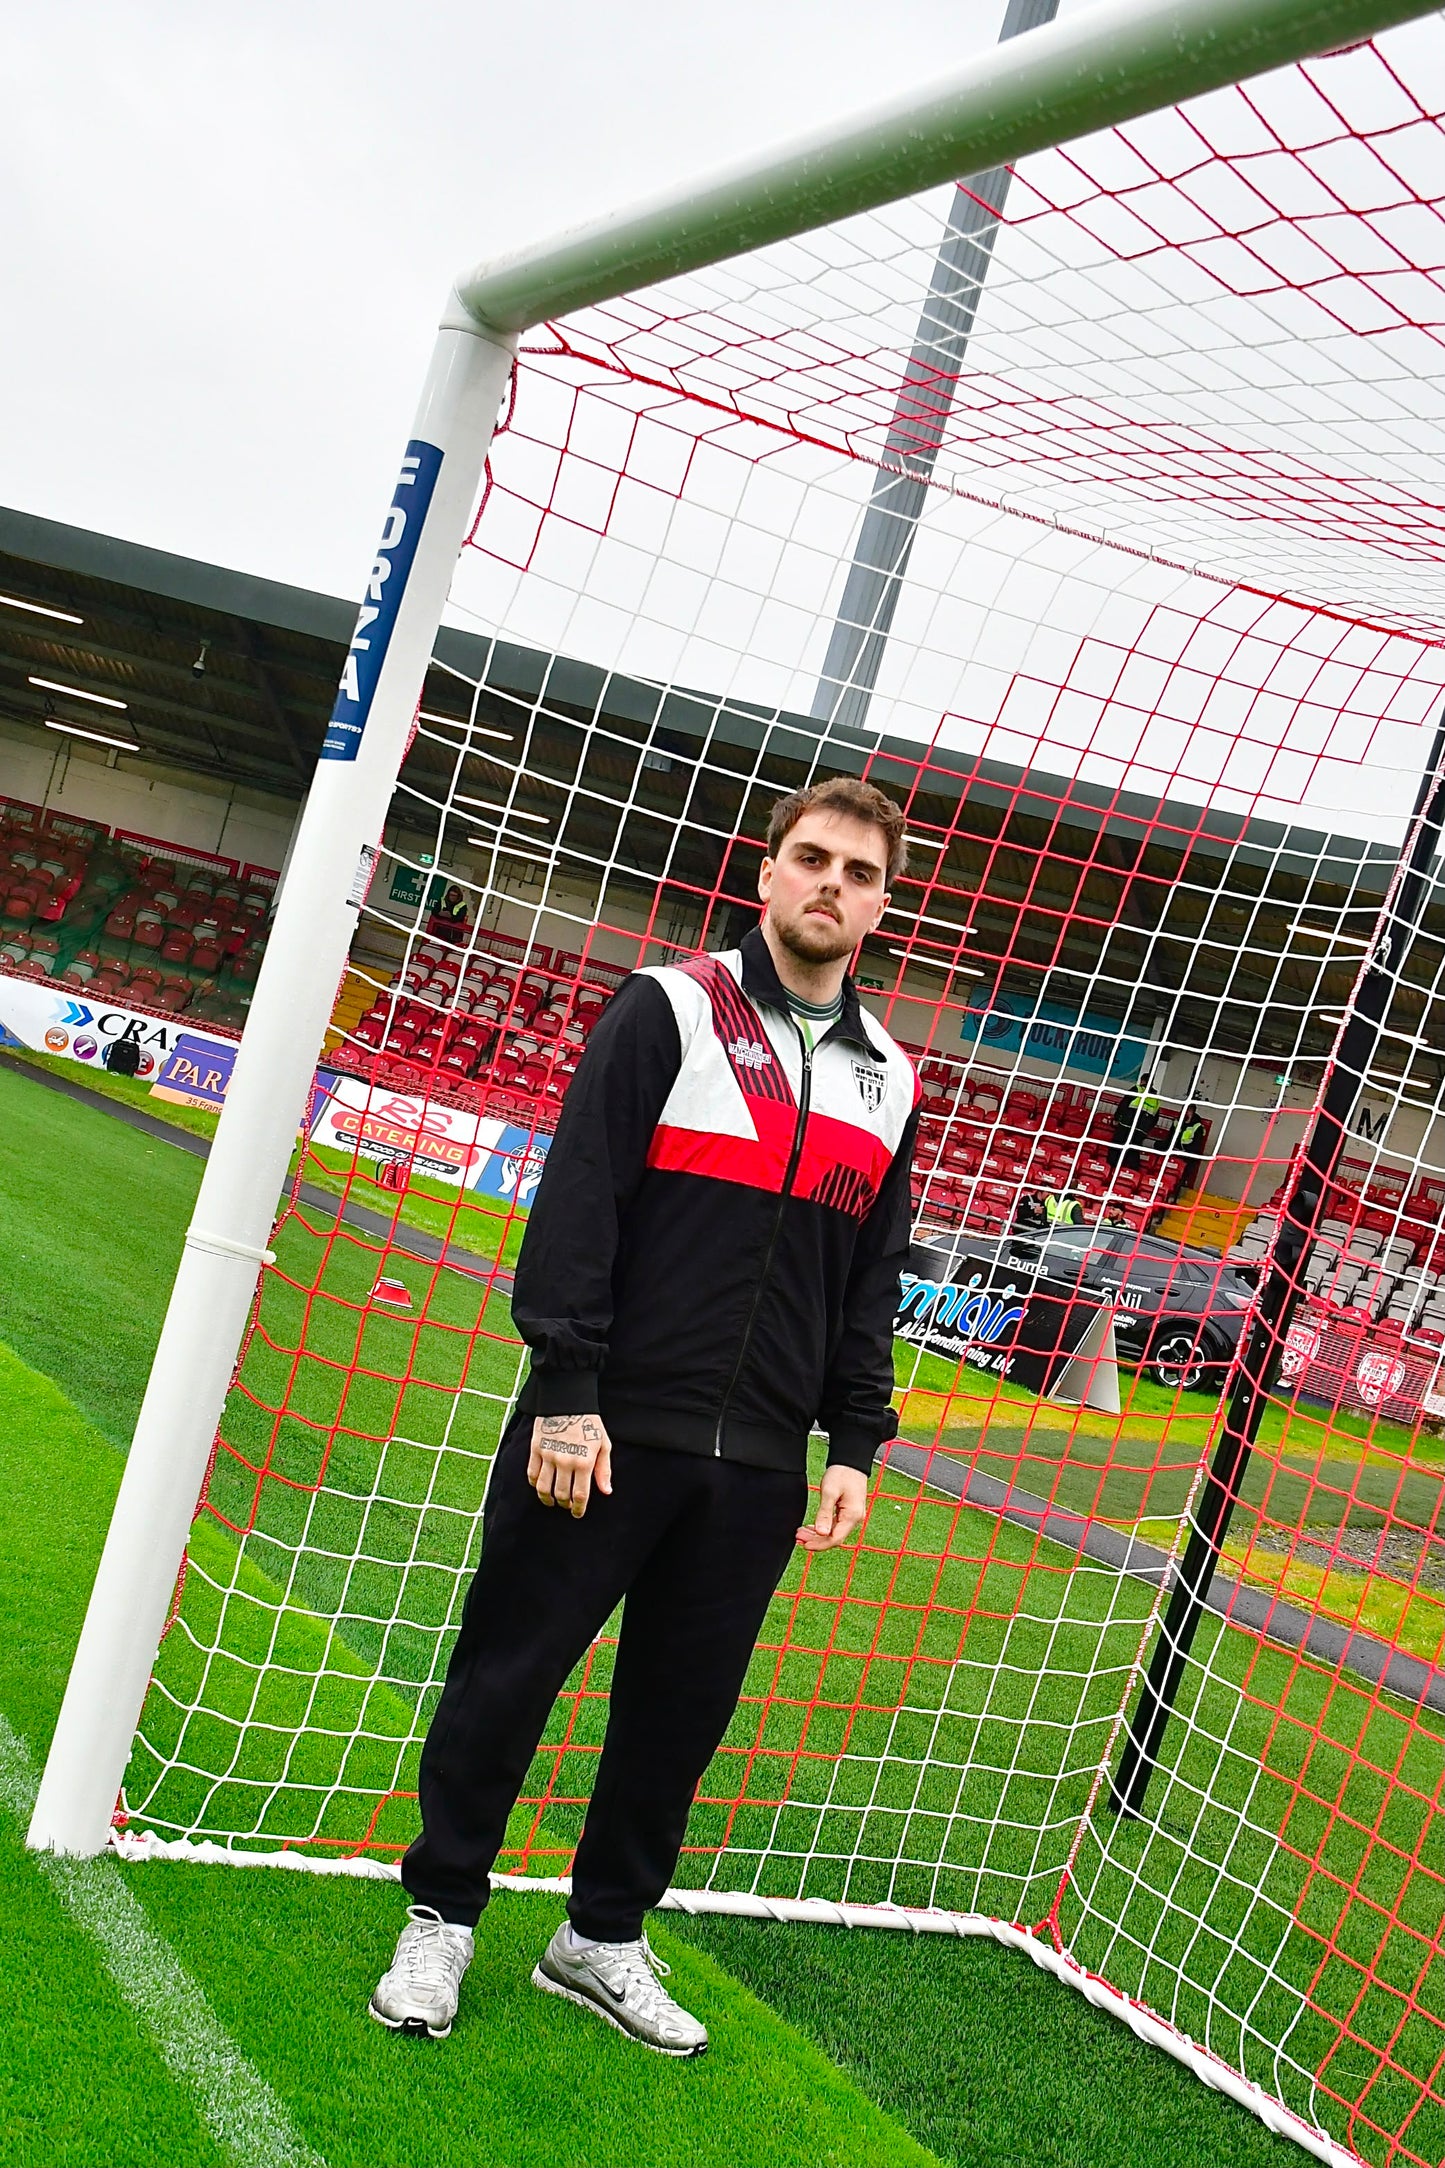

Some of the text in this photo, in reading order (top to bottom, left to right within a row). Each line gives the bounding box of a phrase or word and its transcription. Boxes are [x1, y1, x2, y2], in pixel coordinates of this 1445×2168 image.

[338, 456, 421, 702] FORZA
[391, 888, 421, 903] FIRST
[97, 1013, 184, 1052] CRA
[186, 1097, 198, 1106] 35
[376, 1097, 453, 1133] RS
[342, 1116, 464, 1161] CATERING
[1355, 1107, 1391, 1145] M
[1007, 1255, 1049, 1276] Puma
